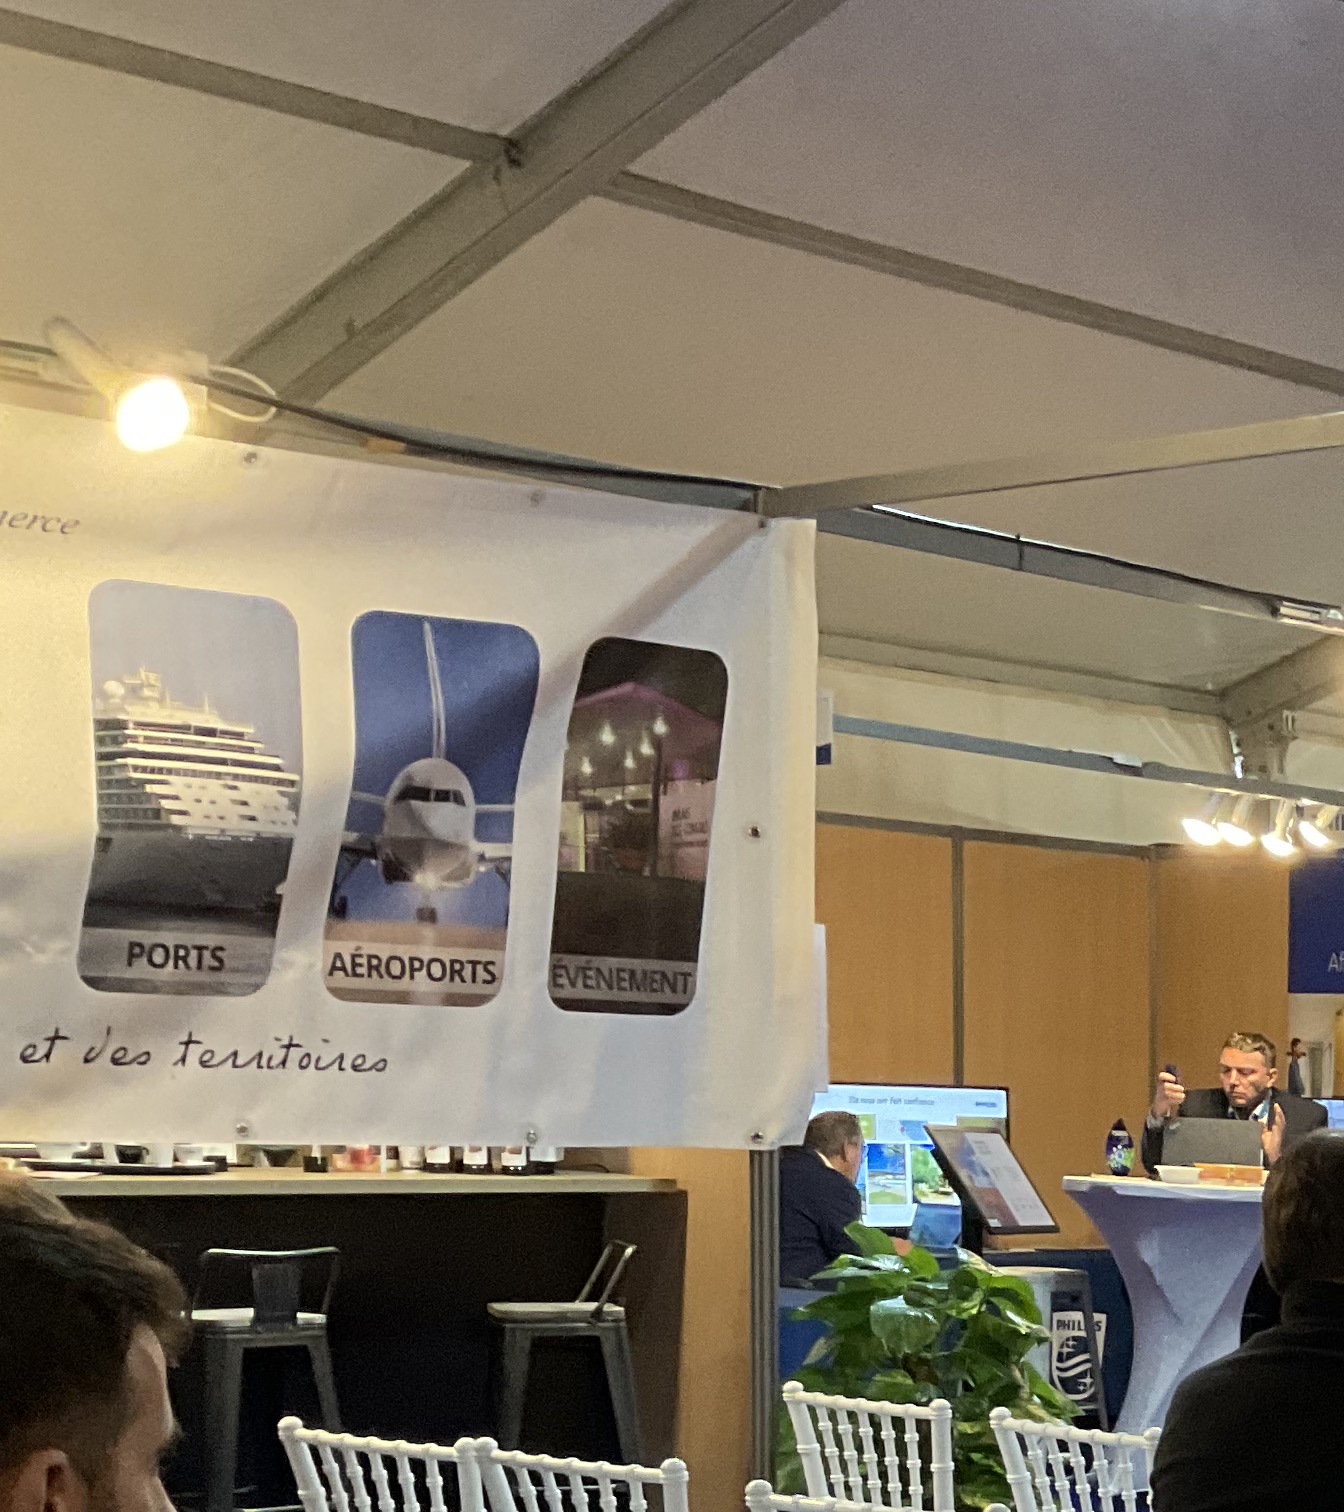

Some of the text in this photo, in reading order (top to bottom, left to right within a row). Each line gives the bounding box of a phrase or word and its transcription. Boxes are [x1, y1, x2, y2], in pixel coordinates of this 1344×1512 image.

[0, 510, 80, 535] erce
[126, 940, 227, 972] PORTS
[327, 945, 497, 985] AÉROPORTS
[552, 957, 693, 995] ÉVÉNEMENT
[18, 1025, 389, 1073] et des territoires
[1056, 1319, 1102, 1332] PHILS
